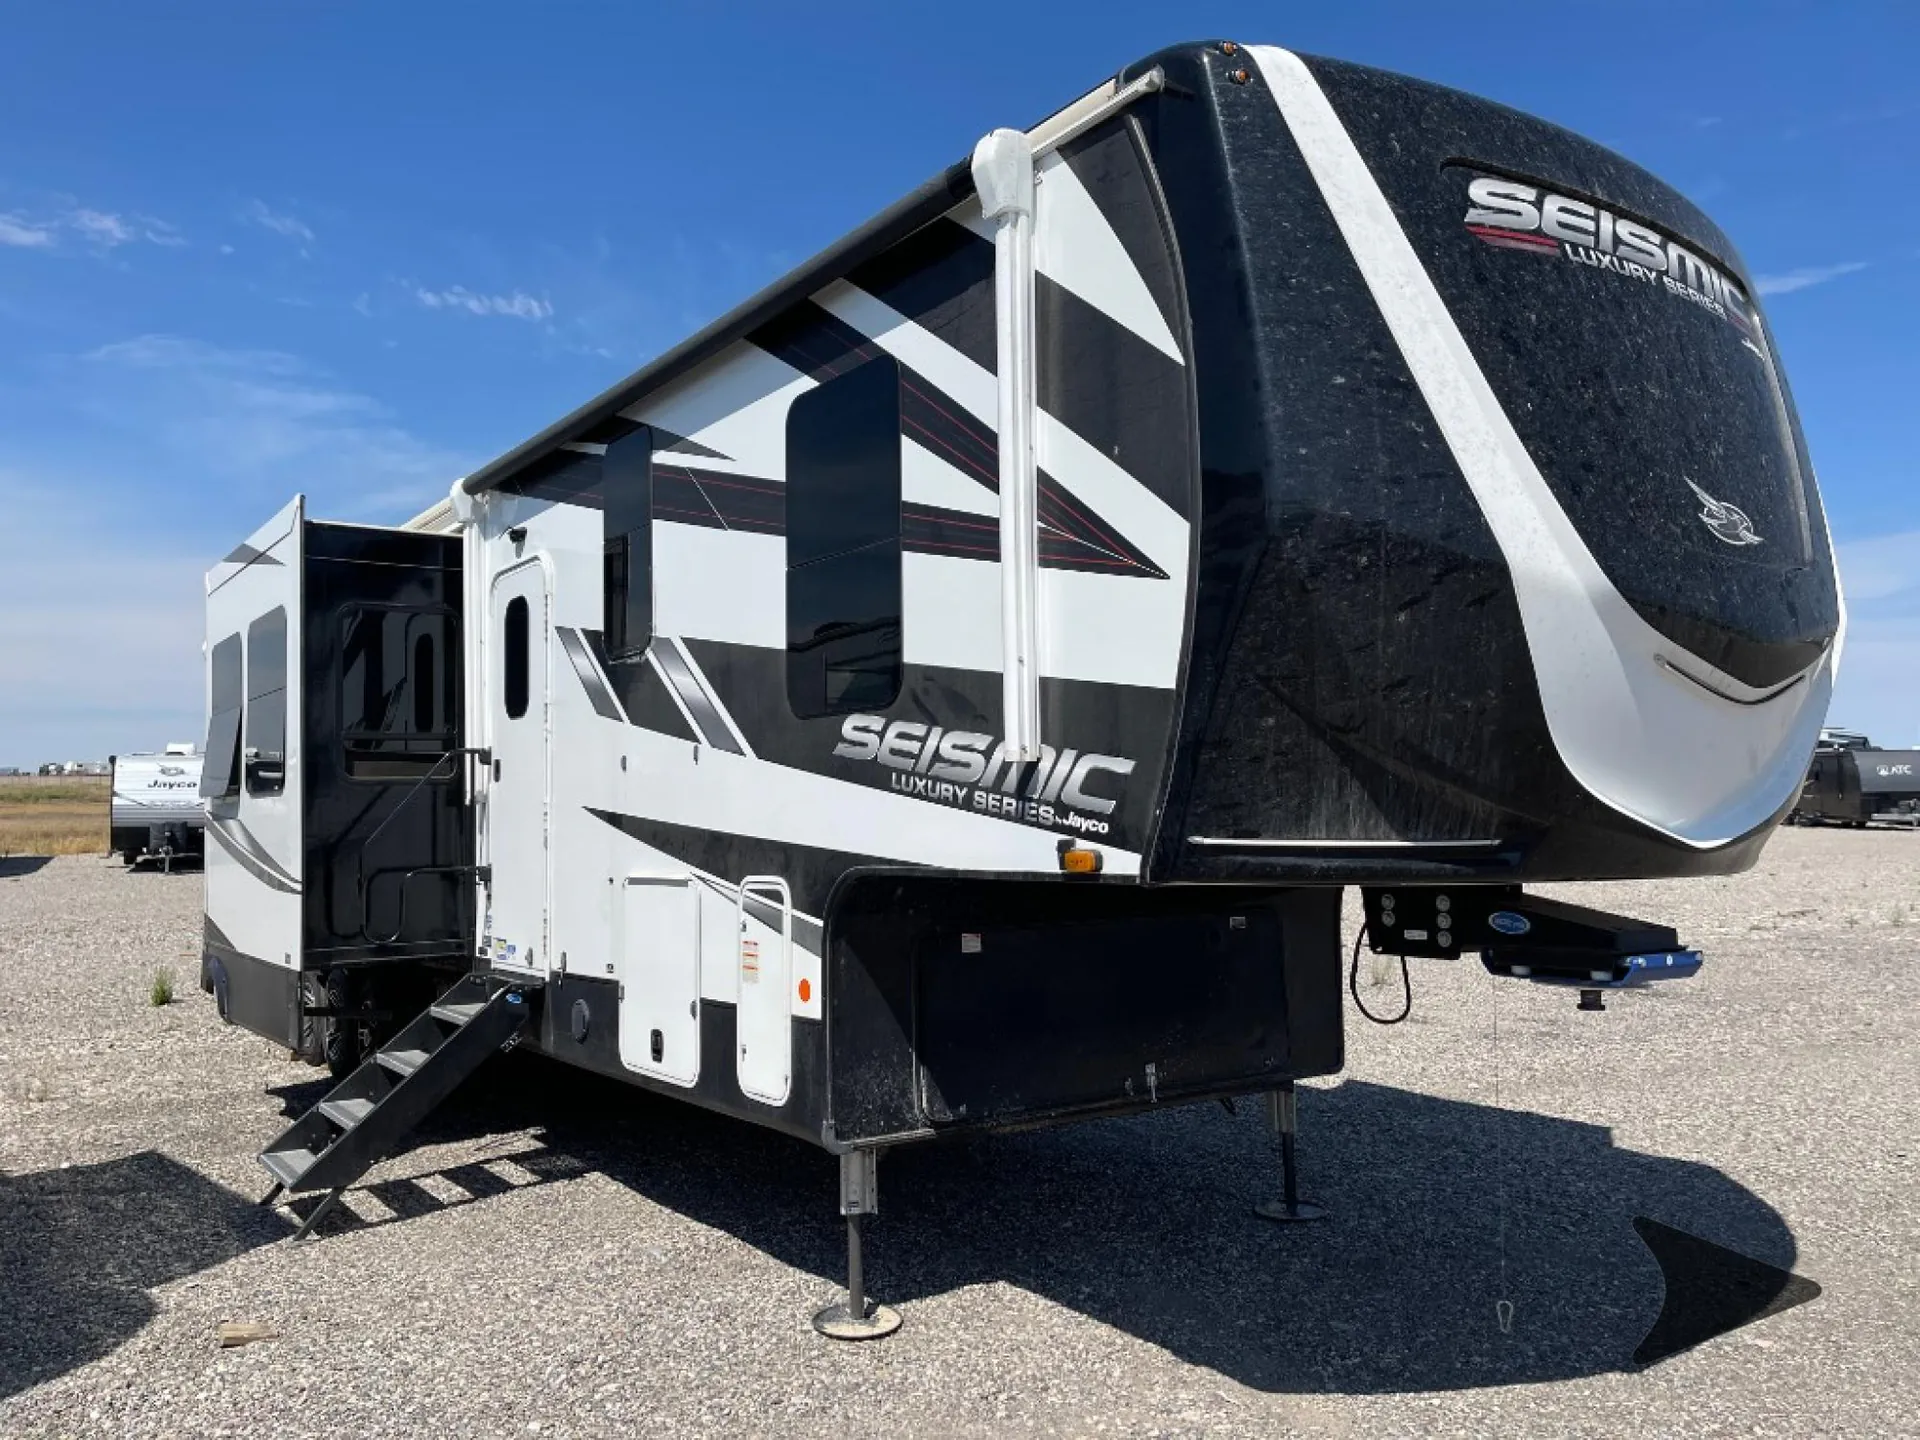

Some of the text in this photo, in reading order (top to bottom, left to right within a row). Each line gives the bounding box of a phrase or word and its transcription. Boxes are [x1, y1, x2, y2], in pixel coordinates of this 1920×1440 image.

[1464, 177, 1752, 327] SEISMIC
[1562, 243, 1728, 321] LUXURY SERIES
[148, 780, 196, 789] Jayco
[832, 713, 1137, 814] SEISMIC
[1891, 764, 1913, 775] ATC
[892, 772, 1108, 833] LUXURY SERIES Jayco
